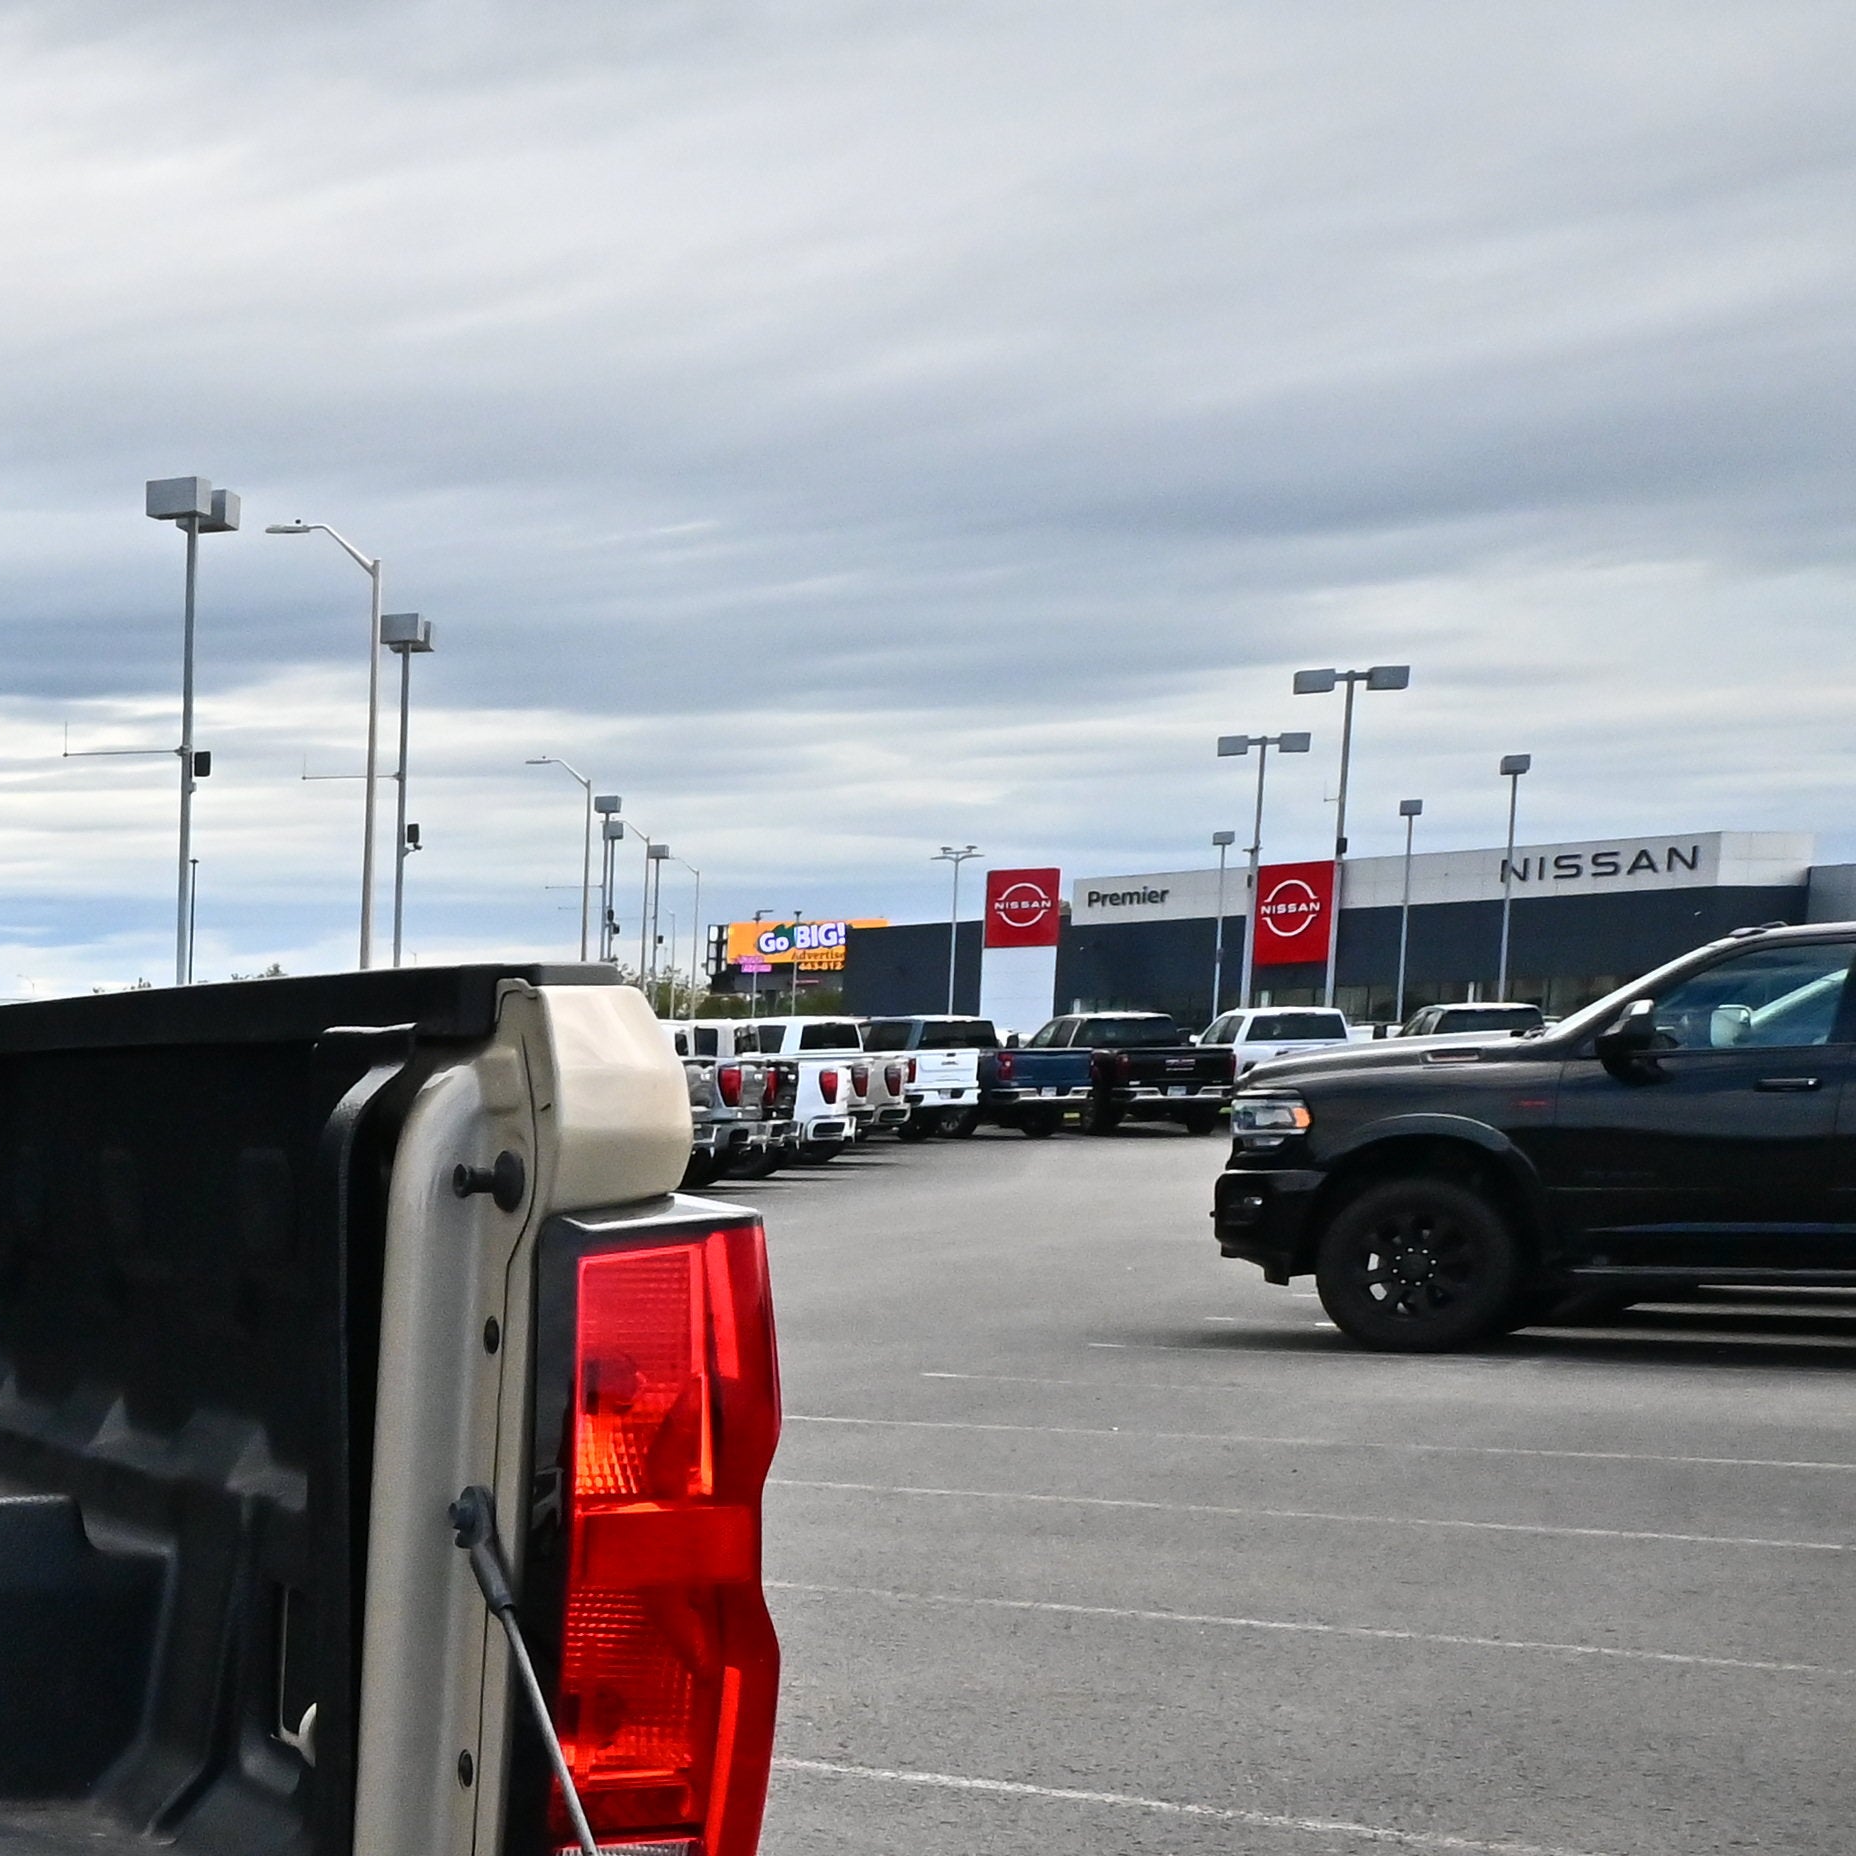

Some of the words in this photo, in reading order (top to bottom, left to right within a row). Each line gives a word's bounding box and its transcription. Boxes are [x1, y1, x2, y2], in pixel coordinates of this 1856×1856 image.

[1500, 845, 1700, 883] NISSAN
[994, 900, 1051, 910] NISSAN
[1087, 886, 1169, 907] Premier
[1260, 901, 1321, 915] NISSAN
[759, 931, 789, 952] Go
[794, 922, 846, 949] BIG!
